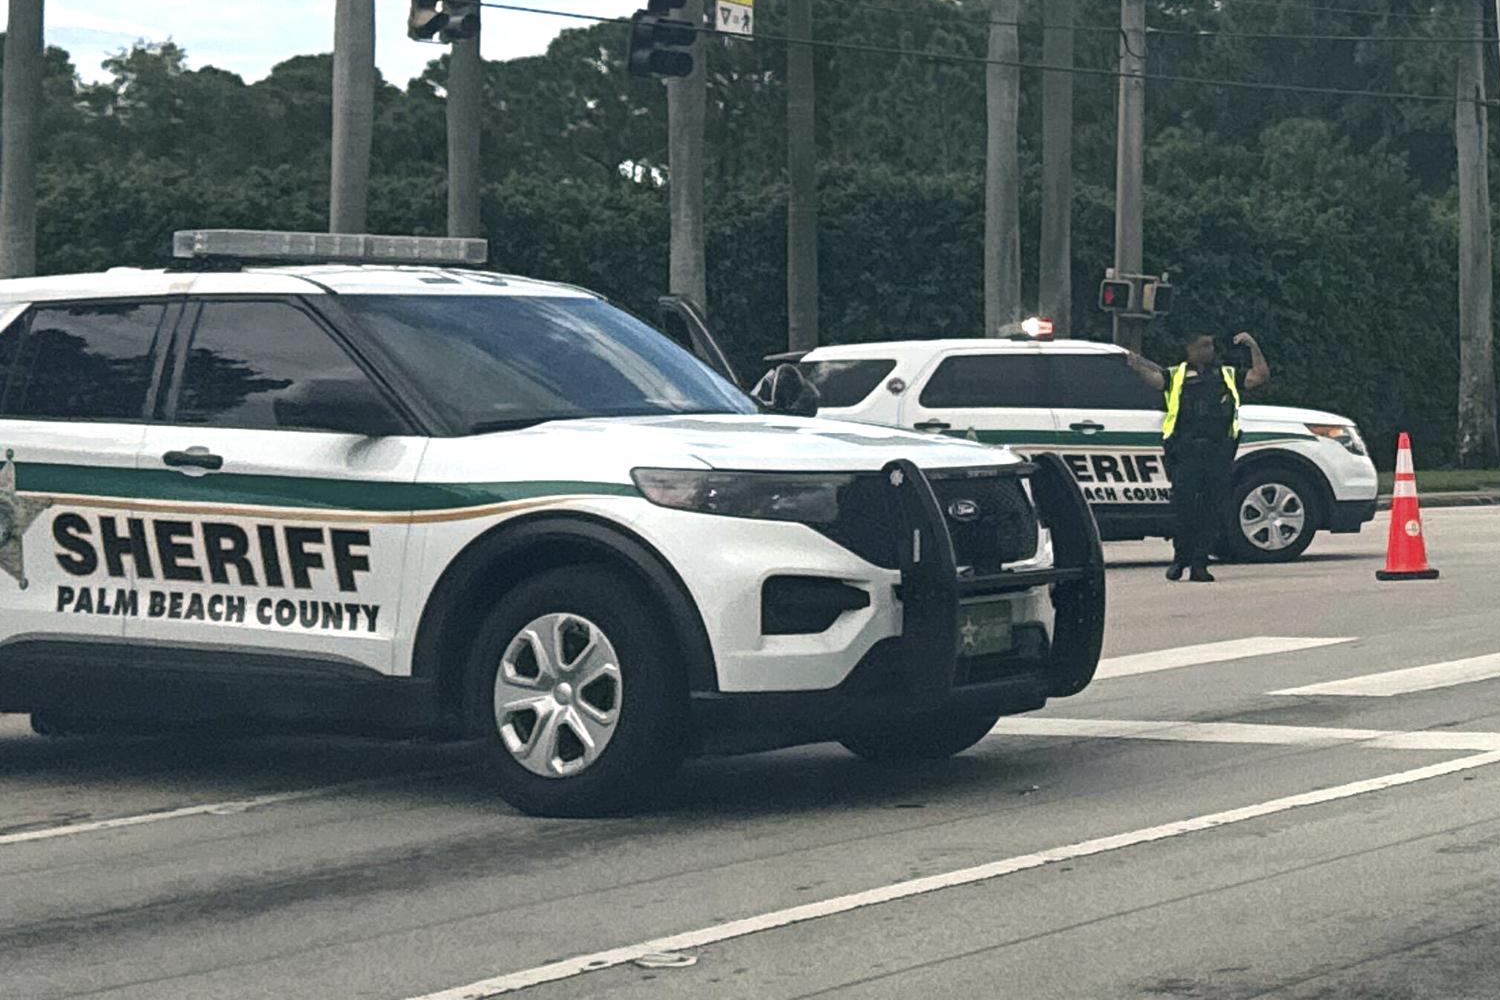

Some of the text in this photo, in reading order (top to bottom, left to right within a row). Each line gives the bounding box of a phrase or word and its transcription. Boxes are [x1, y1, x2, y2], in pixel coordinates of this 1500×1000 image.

[1061, 454, 1172, 483] ERIF
[1123, 487, 1172, 501] COUN
[52, 511, 372, 593] SHERIFF
[56, 585, 381, 633] PALM BEACH COUNTY
